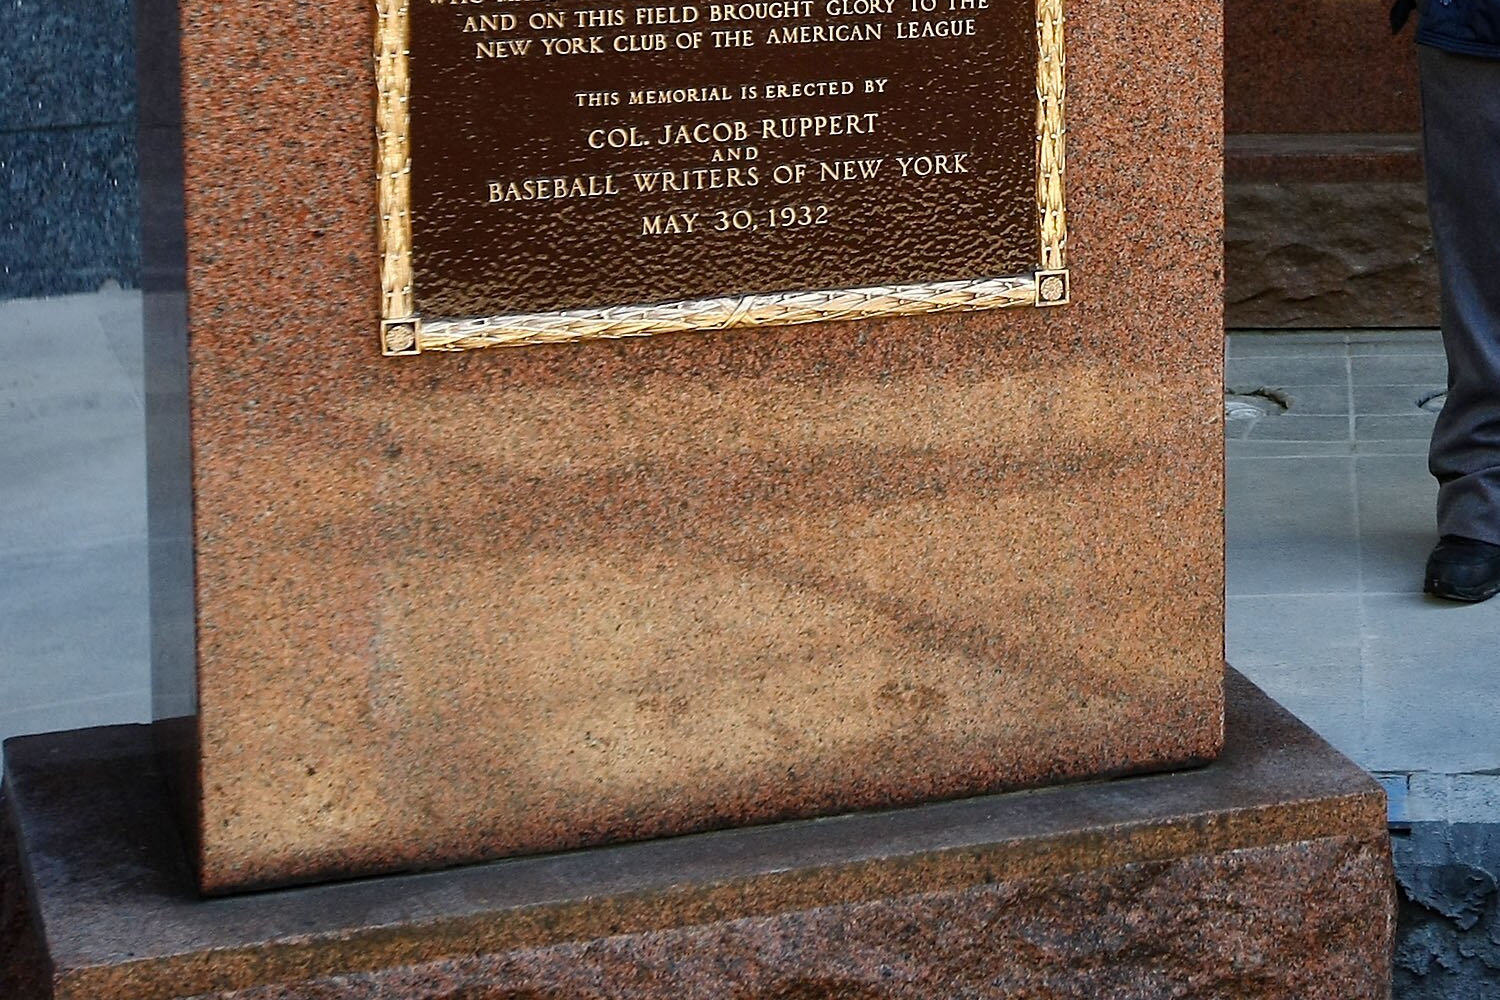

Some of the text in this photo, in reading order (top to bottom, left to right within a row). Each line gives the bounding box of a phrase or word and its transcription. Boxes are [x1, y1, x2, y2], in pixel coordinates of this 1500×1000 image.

[463, 14, 517, 33] AND
[529, 12, 564, 29] ON
[574, 9, 625, 27] THIS
[636, 6, 699, 25] FIELD
[710, 1, 814, 22] BROUGHT
[476, 19, 976, 59] NEW YORK CLUB OF THE AMERICAN LEAGUE
[575, 79, 887, 107] THIS MEMORIAL IS ERECTED BY
[588, 113, 879, 149] COL. JACOB RUPPERT
[711, 147, 759, 163] AND
[488, 153, 969, 202] BASEBALL WRITERS OF NEW YORK
[641, 204, 829, 236] MAY 30, 1932
